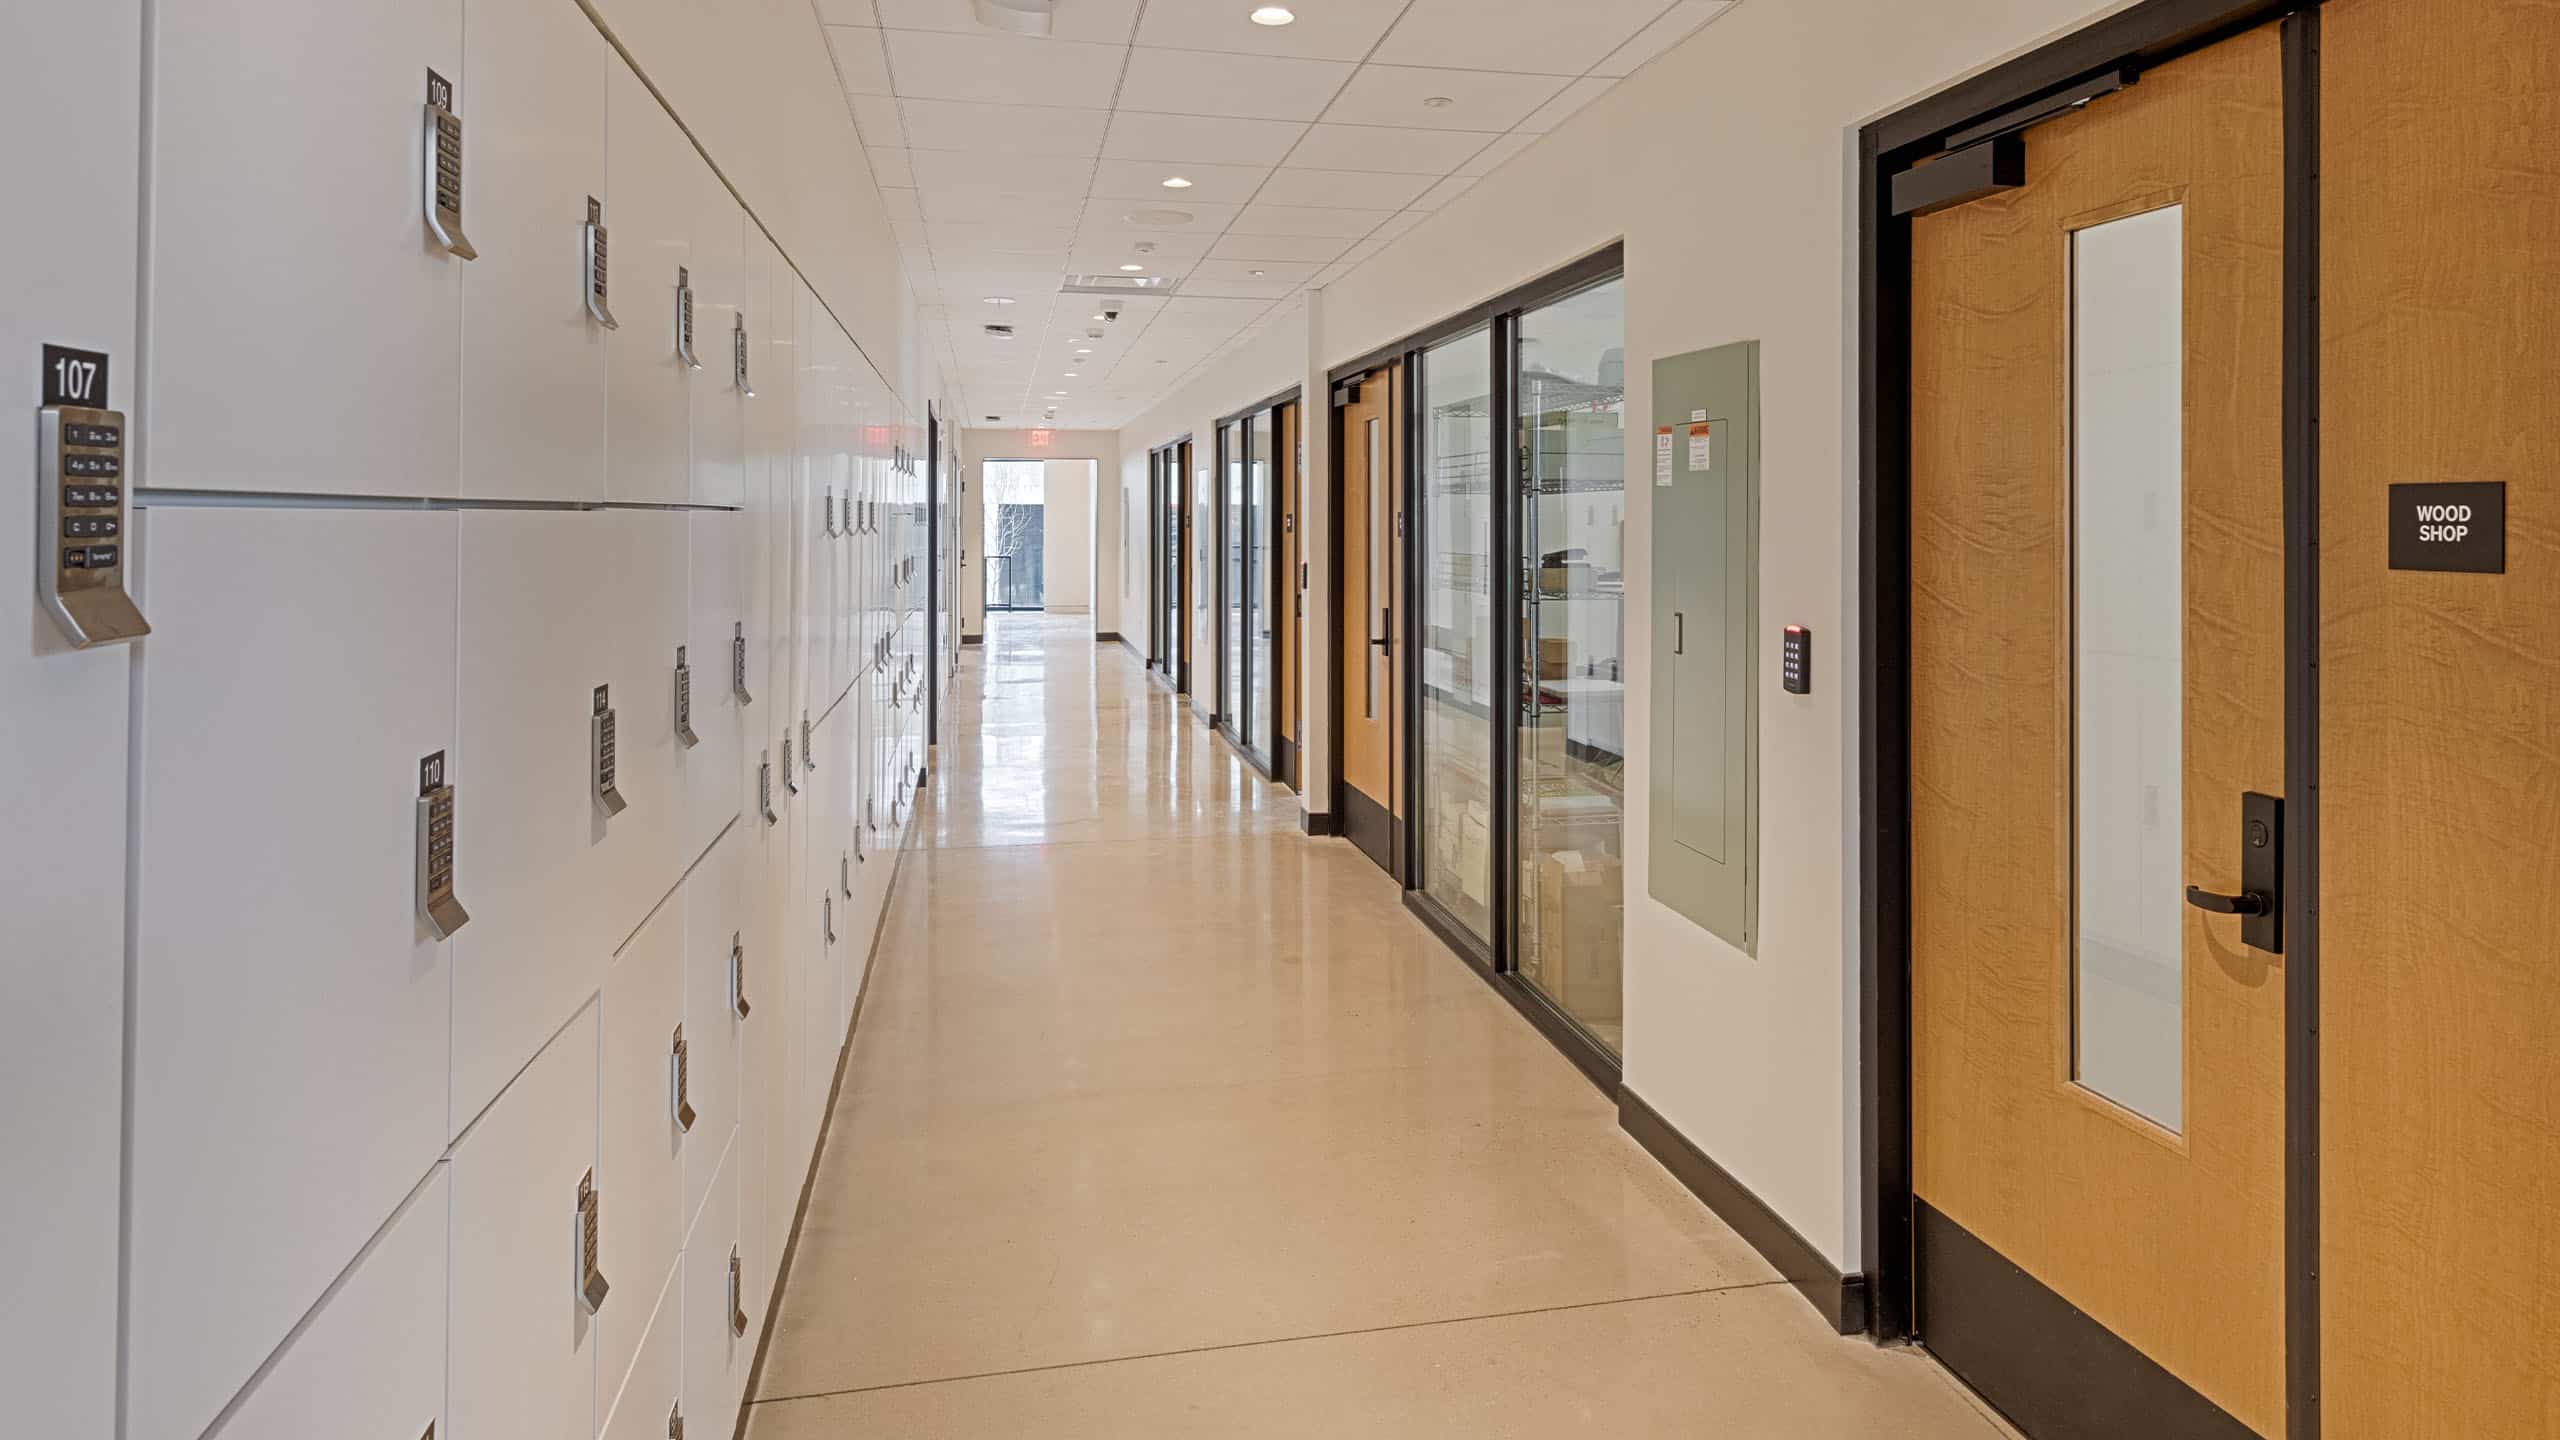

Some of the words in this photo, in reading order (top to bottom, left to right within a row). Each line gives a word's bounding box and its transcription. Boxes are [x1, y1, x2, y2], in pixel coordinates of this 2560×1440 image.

[431, 79, 448, 109] 109
[55, 358, 97, 400] 107
[2416, 505, 2472, 522] WOOD
[2419, 525, 2468, 542] SHOP
[424, 759, 440, 787] 110
